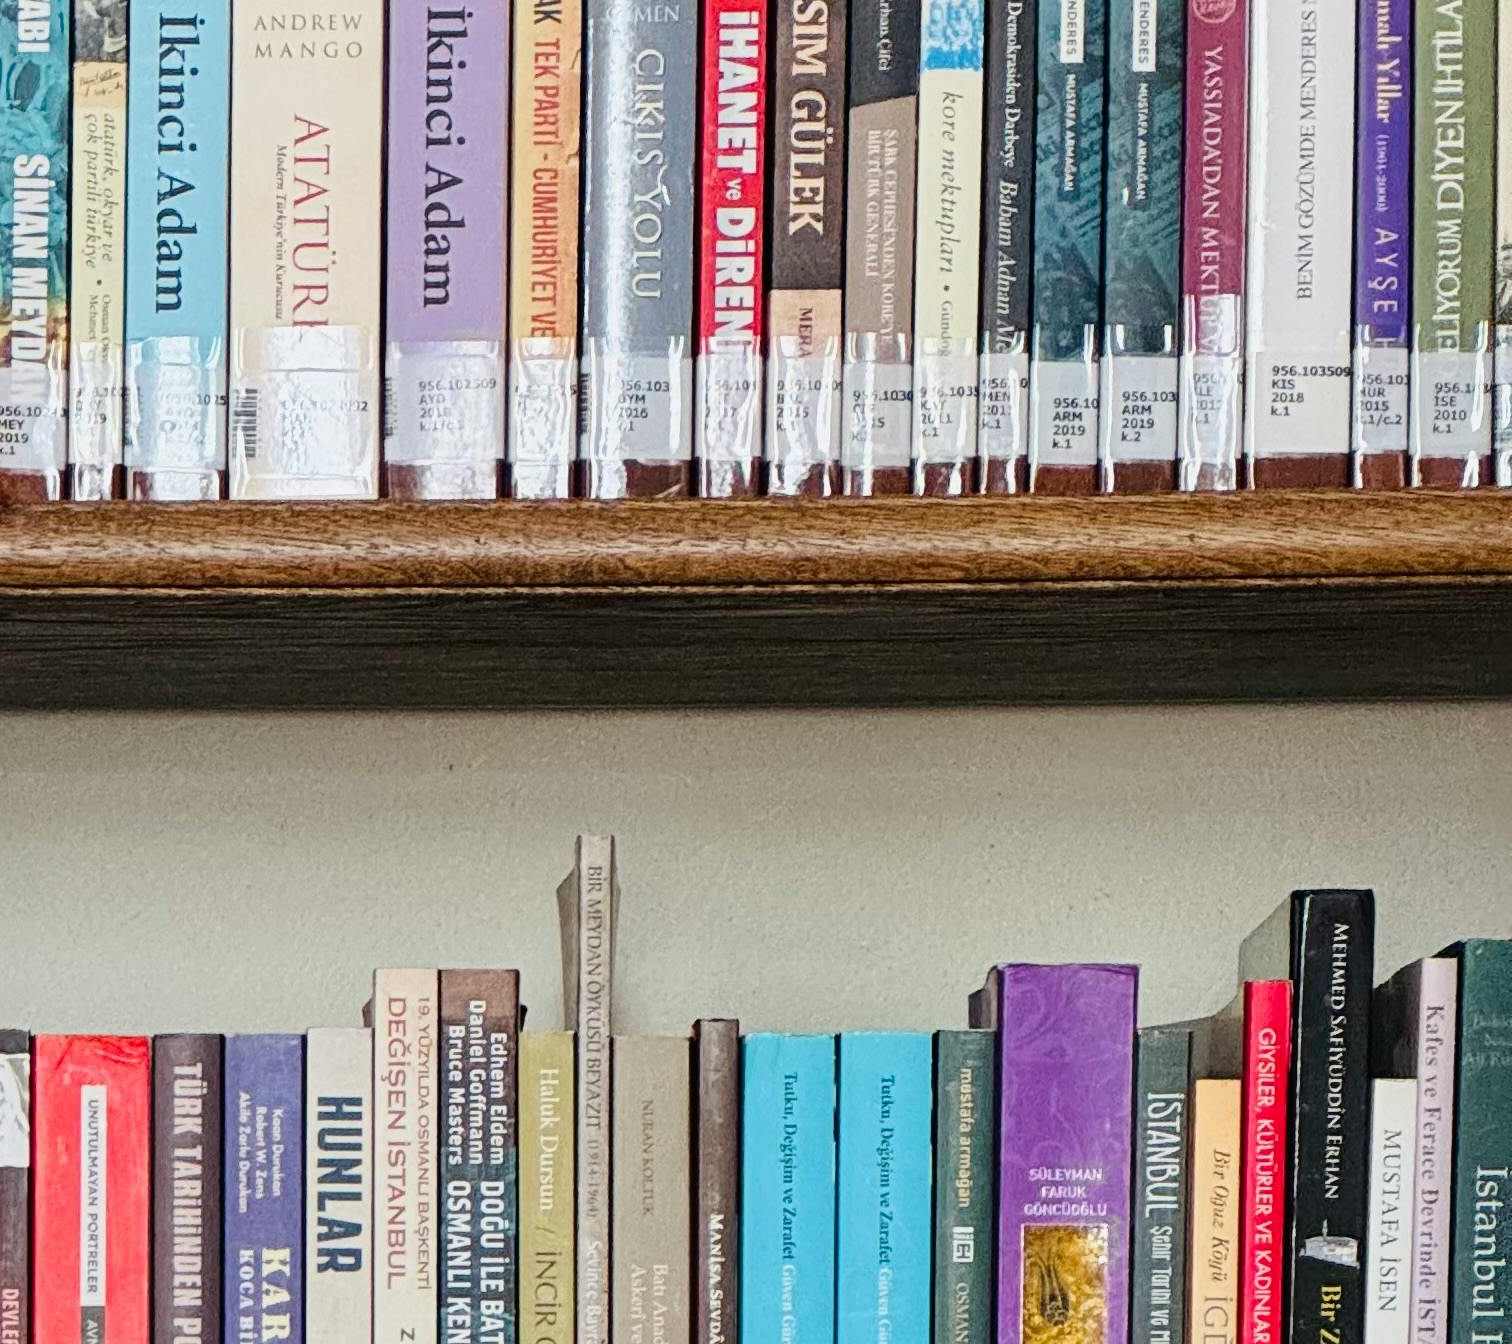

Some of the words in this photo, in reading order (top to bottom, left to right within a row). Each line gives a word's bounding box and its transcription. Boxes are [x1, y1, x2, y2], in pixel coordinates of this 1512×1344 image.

[253, 14, 364, 31] ANDREW
[254, 41, 364, 58] MANGO
[533, 37, 561, 76] TEK
[158, 12, 206, 151] İkinci
[426, 5, 474, 149] İkinci
[1300, 9, 1316, 119] MENDERES
[941, 91, 963, 141] kore
[788, 90, 834, 235] GÜLEK
[1298, 125, 1316, 229] GÖZÜMDE
[155, 170, 197, 314] Adam
[423, 163, 466, 308] Adam
[530, 168, 563, 303] CUMHURİYET
[934, 149, 962, 274] mektupları
[1295, 235, 1316, 299] BENİM
[382, 997, 412, 1131] DEĞİŞEN
[447, 1025, 466, 1083] Bruce
[468, 1000, 487, 1063] Daniel
[488, 1033, 507, 1101] Edhem
[172, 1063, 206, 1135] TÜRK
[447, 1088, 466, 1165] Masters
[488, 1105, 507, 1165] Eldem
[538, 1068, 559, 1131] Haluk
[958, 1068, 975, 1132] mustafa
[86, 1100, 99, 1207] UNUTULMAYAN
[538, 1135, 559, 1210] Dursun
[952, 1135, 975, 1209] armağan
[1145, 1092, 1184, 1218] İSTANBUL
[1212, 1150, 1231, 1179] Bir
[1254, 1119, 1278, 1217] KÜLTÜRLER
[1421, 1107, 1442, 1181] Ferace
[316, 1096, 363, 1274] HUNLAR
[387, 1140, 411, 1289] İSTANBUL
[479, 1180, 507, 1249] DOĞU
[1380, 1130, 1401, 1249] MUSTAFA
[86, 1213, 99, 1294] PORTRELER
[172, 1145, 202, 1307] TARİHİNDEN
[446, 1180, 473, 1291] OSMANLI
[877, 1212, 894, 1264] Zarafet
[1254, 1222, 1273, 1244] VE
[1417, 1187, 1440, 1289] Devrinde
[239, 1249, 255, 1309] KOCA
[479, 1256, 508, 1294] İLE
[534, 1251, 561, 1328] İNCİR
[1251, 1249, 1273, 1343] KADINLAR
[1320, 1284, 1343, 1320] Bir
[1378, 1256, 1402, 1312] İSEN
